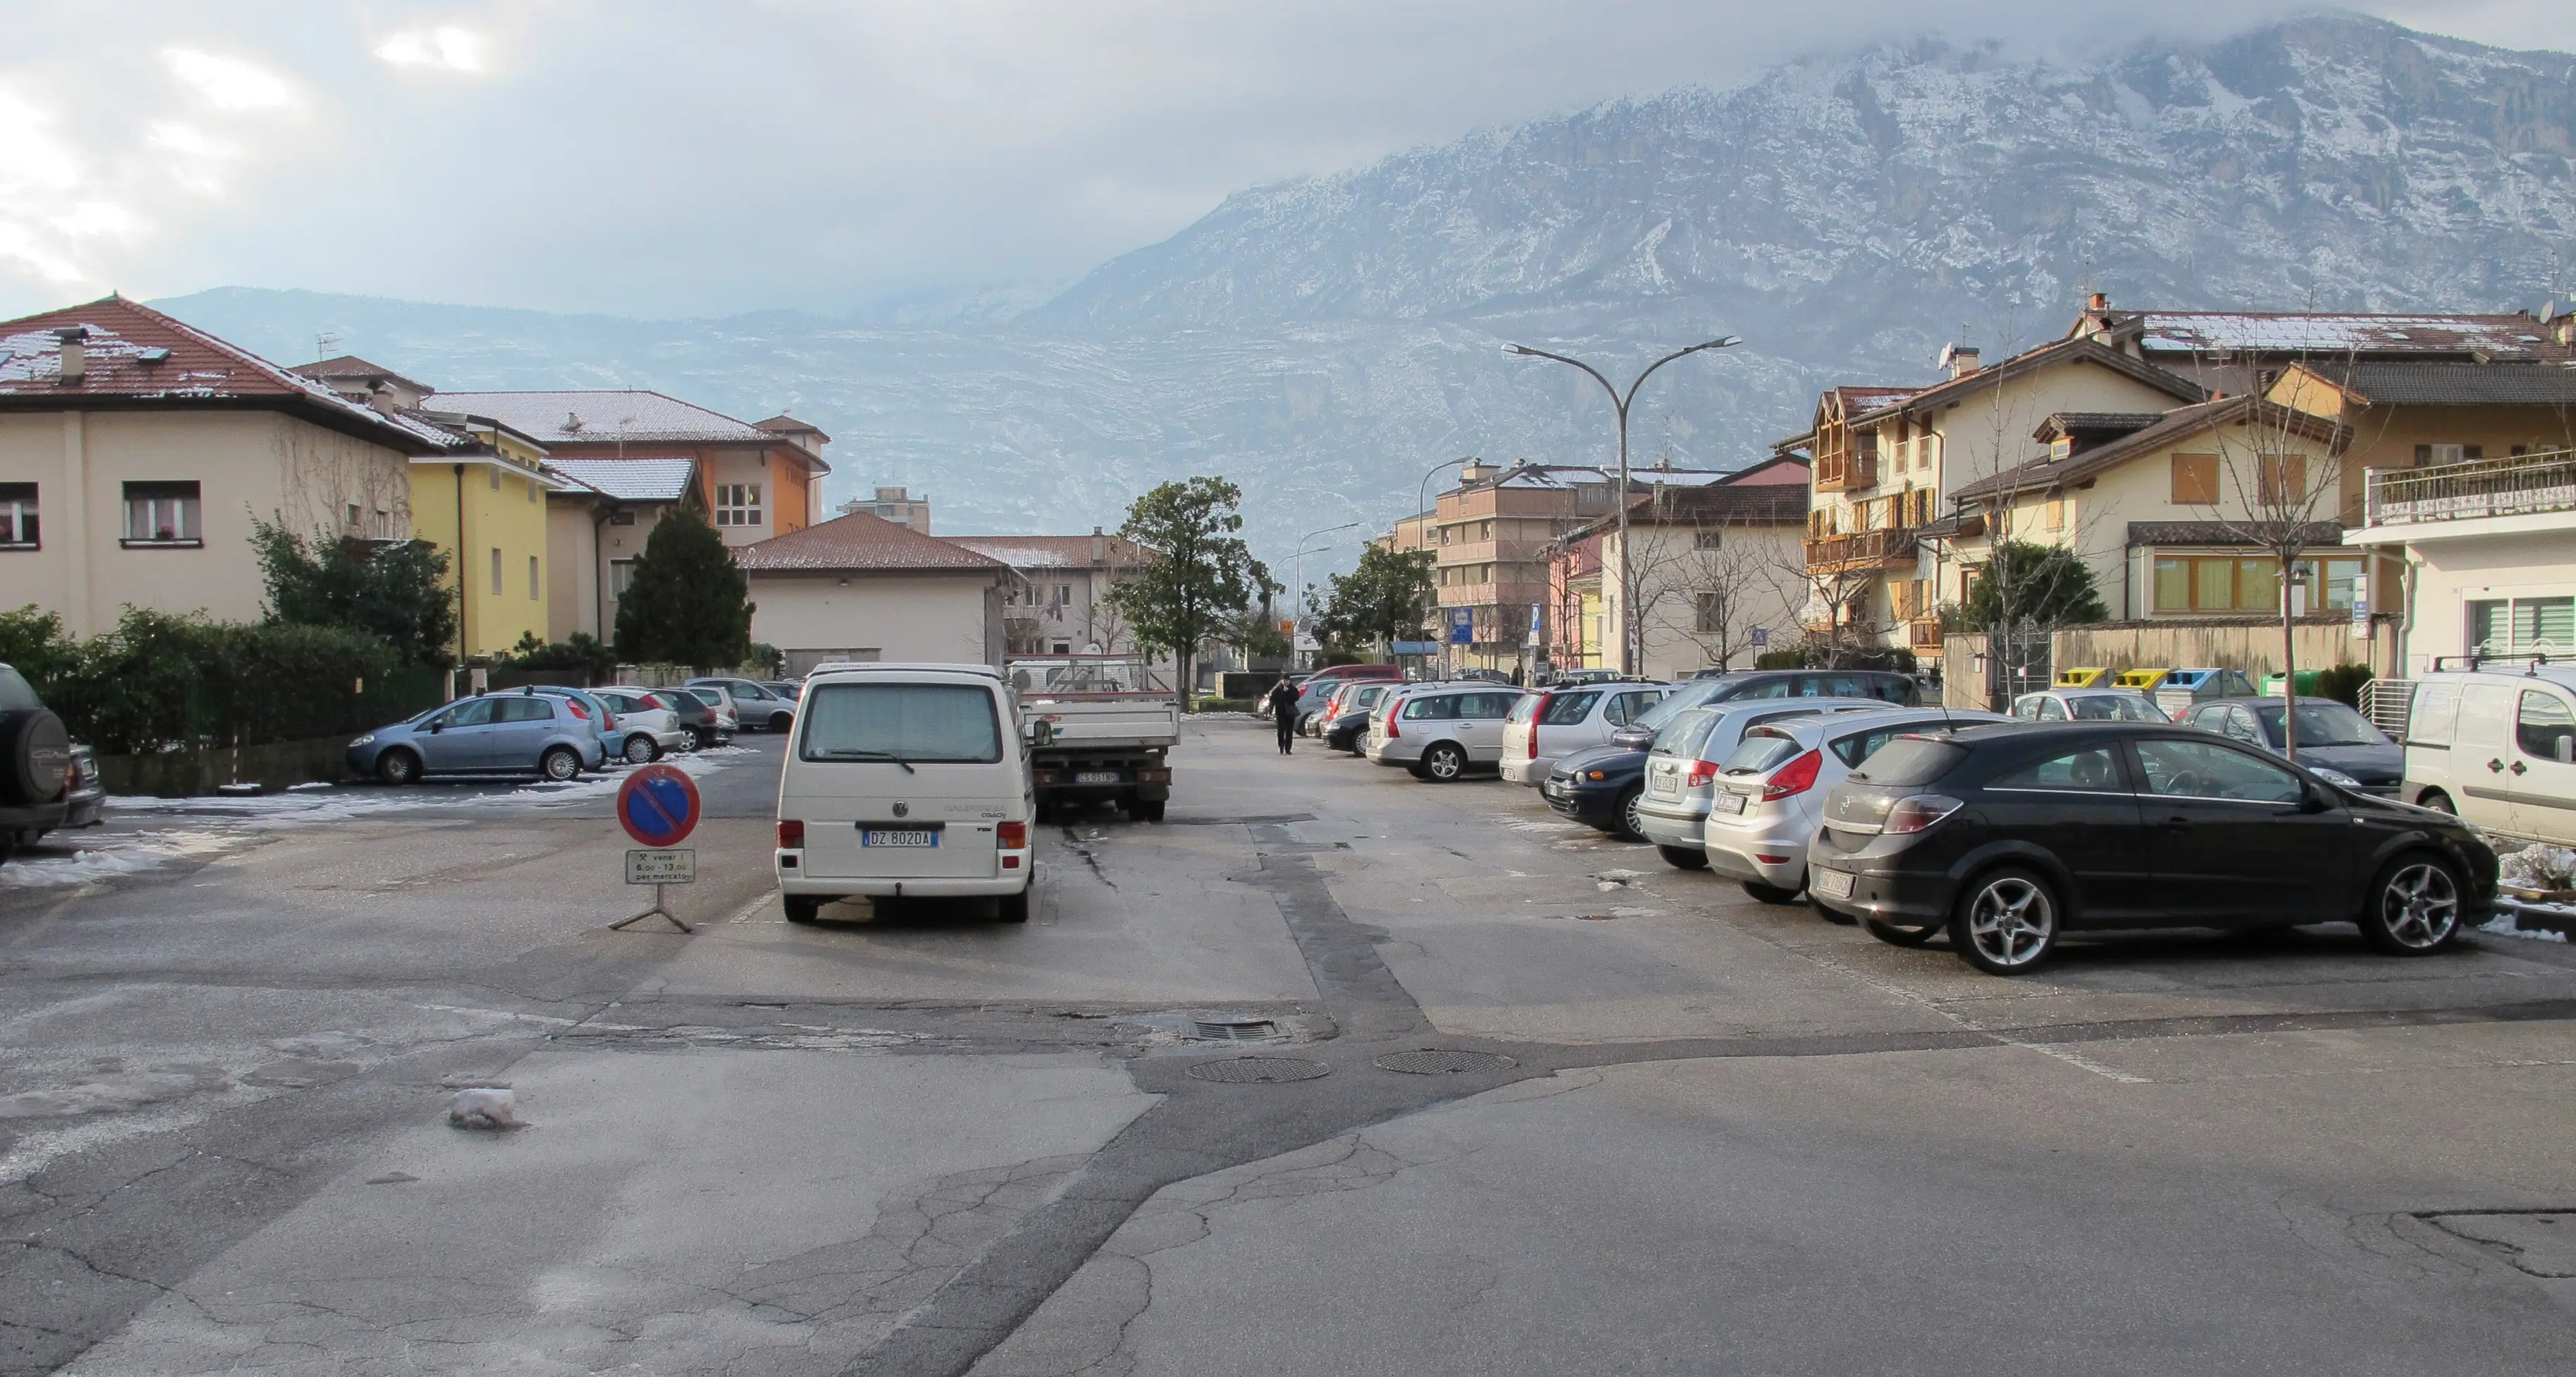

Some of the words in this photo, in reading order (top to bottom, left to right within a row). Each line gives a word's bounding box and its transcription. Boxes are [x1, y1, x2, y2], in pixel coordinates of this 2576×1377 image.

[1532, 607, 1539, 628] P
[871, 833, 886, 845] DZ
[891, 833, 929, 845] 802DA
